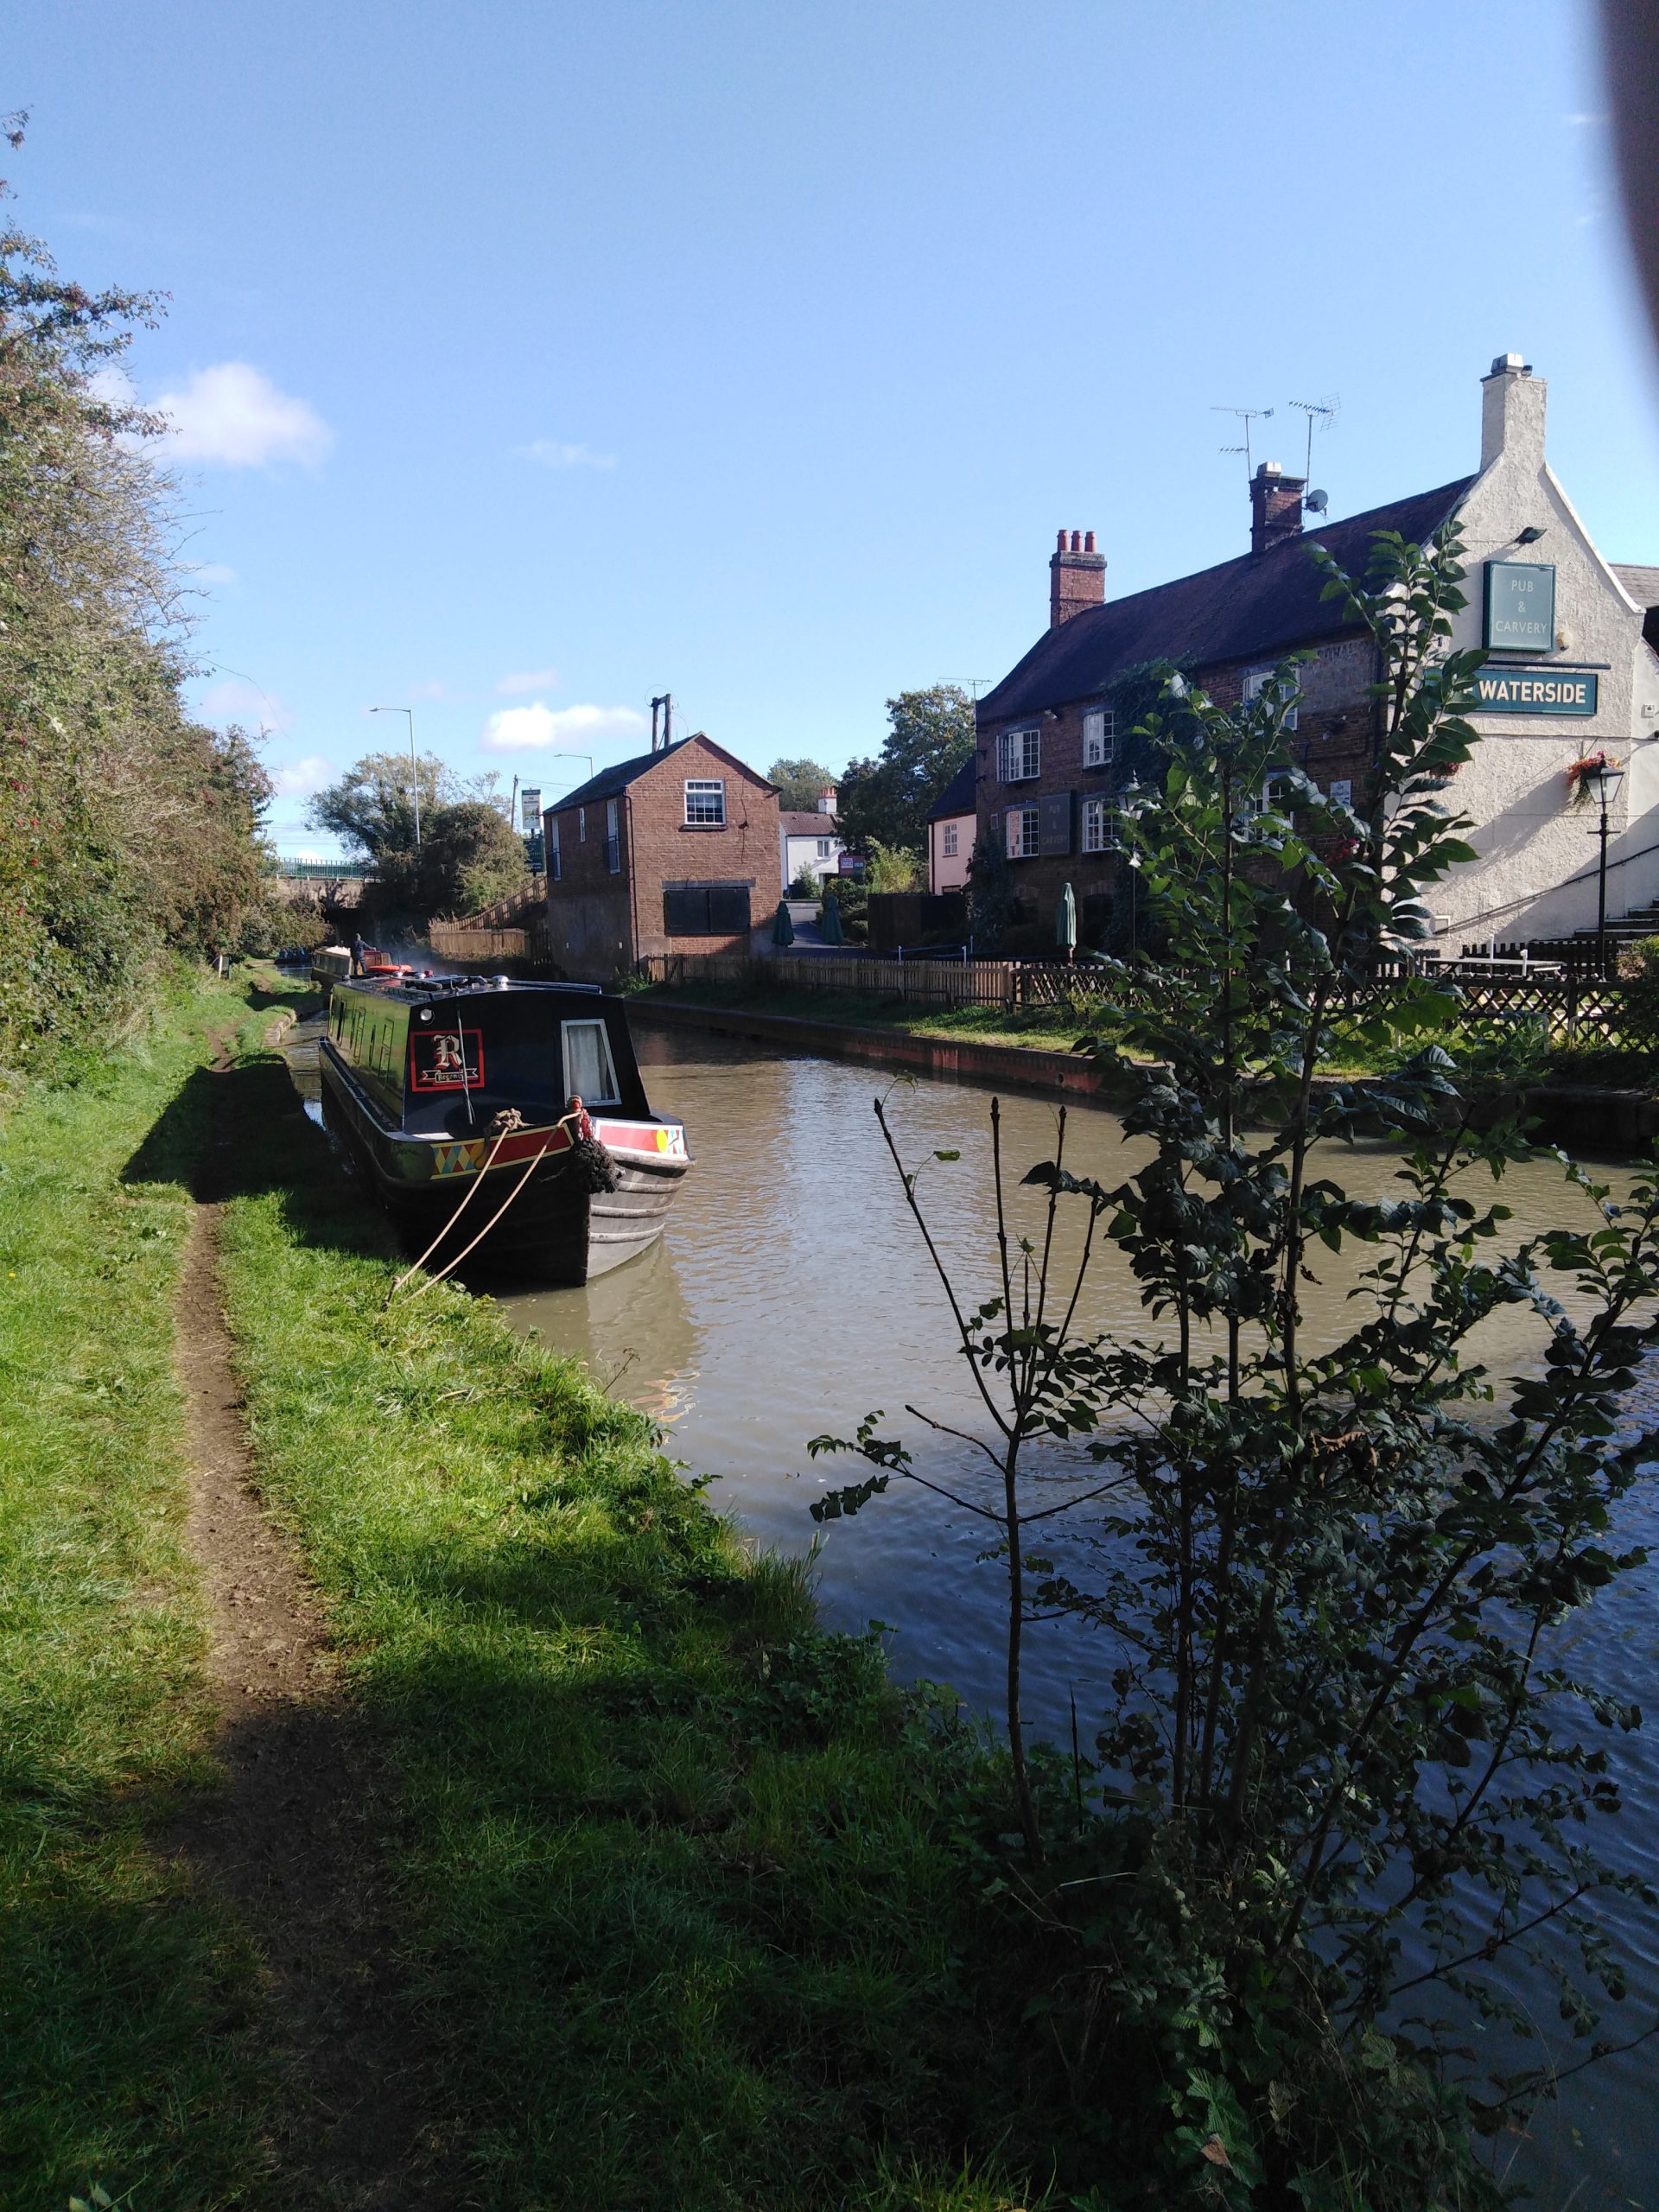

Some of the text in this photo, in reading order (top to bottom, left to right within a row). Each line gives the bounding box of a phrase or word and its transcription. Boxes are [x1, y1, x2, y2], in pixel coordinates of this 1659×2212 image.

[1511, 580, 1534, 593] PUB
[1517, 601, 1526, 613] &
[1495, 620, 1548, 633] CARVERY
[1478, 679, 1586, 704] WATERSIDE
[1049, 804, 1061, 814] PUB
[433, 1034, 462, 1069] R
